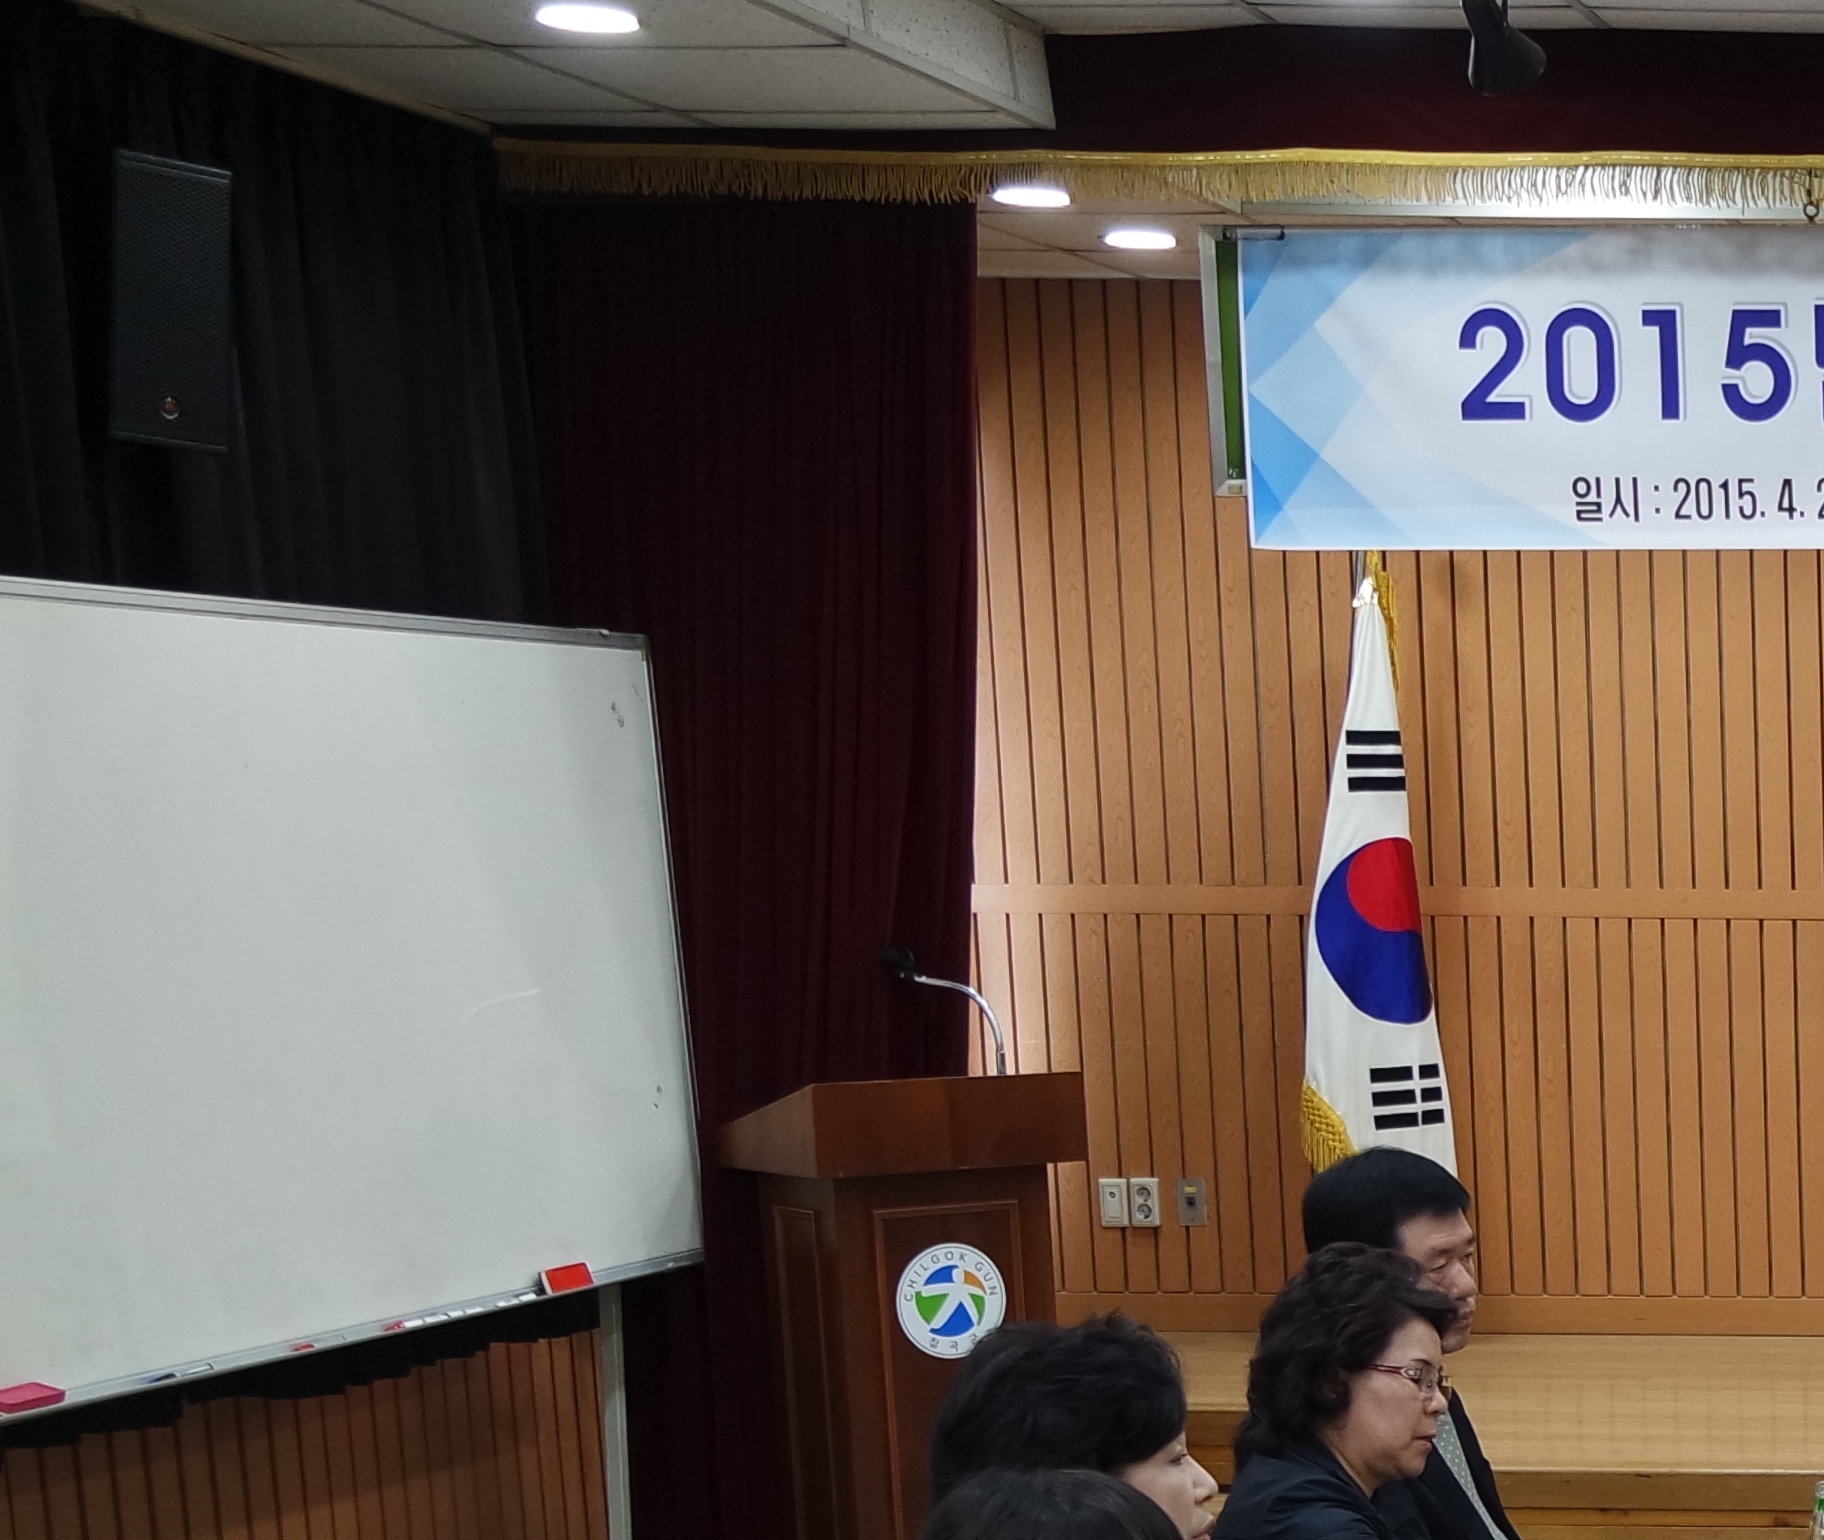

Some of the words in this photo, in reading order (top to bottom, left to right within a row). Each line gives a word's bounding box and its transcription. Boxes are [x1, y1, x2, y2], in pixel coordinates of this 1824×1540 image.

[1572, 476, 1640, 522] 일시
[1673, 477, 1767, 519] 2015.
[1777, 477, 1805, 519] 4.
[903, 1250, 968, 1303] CHILGOK
[974, 1261, 999, 1297] GUN
